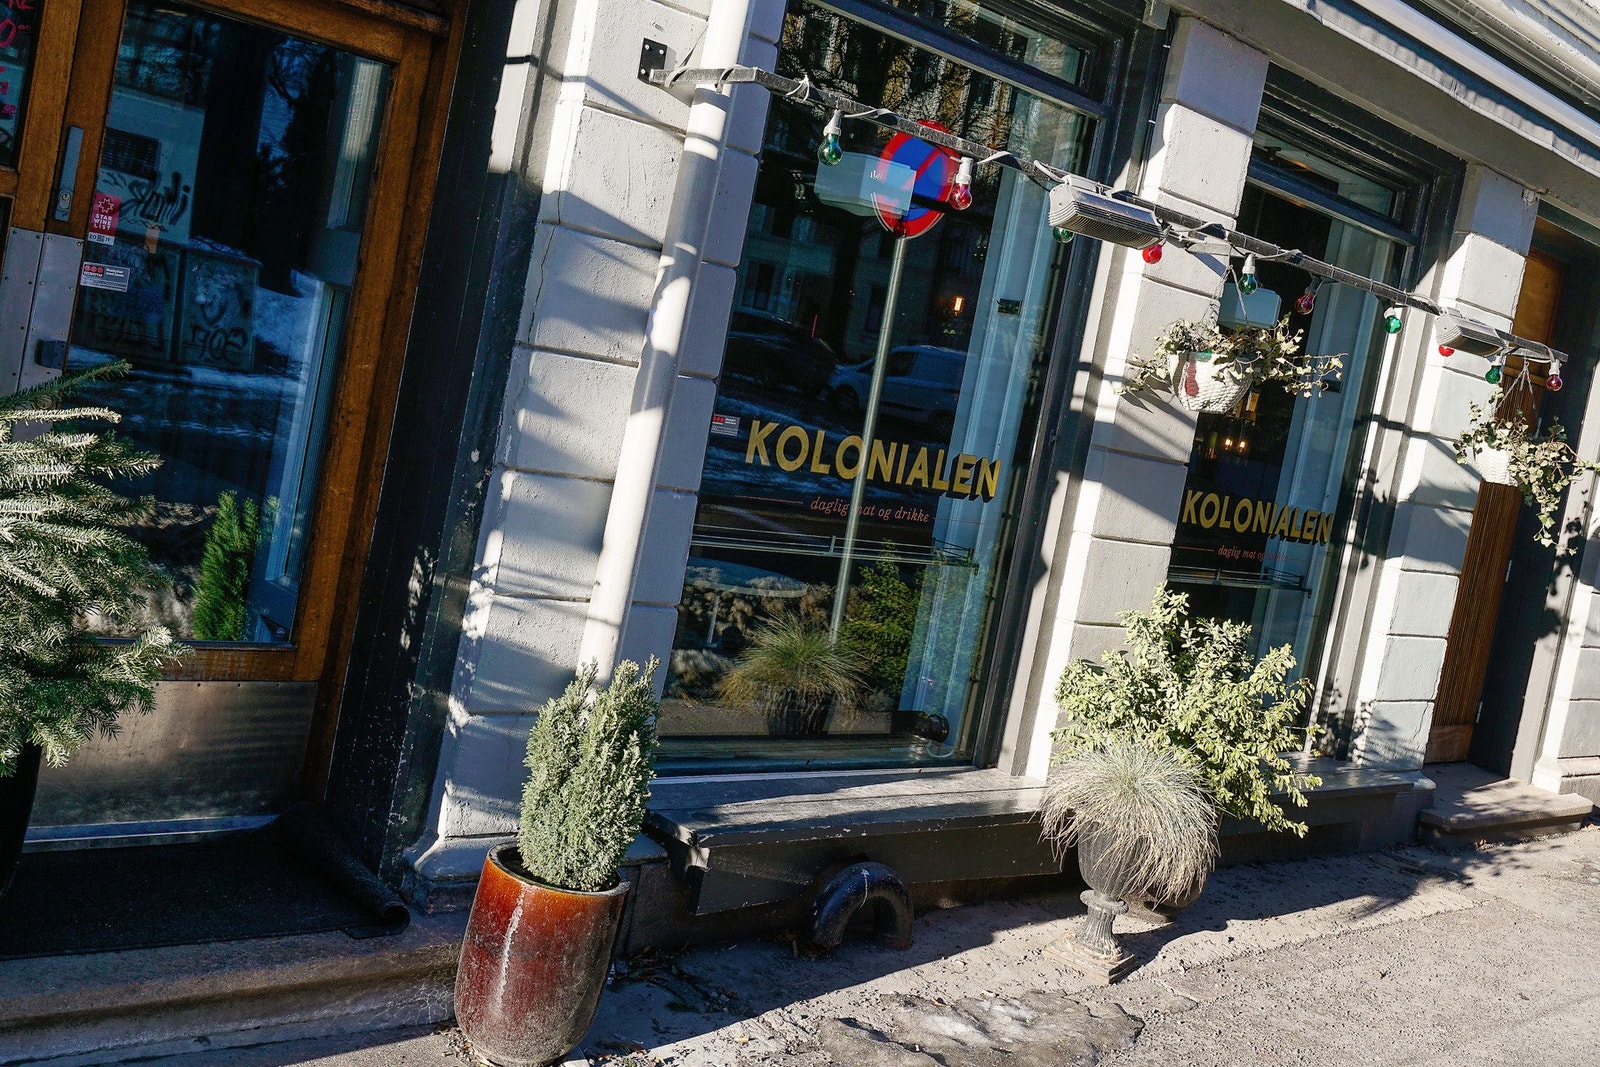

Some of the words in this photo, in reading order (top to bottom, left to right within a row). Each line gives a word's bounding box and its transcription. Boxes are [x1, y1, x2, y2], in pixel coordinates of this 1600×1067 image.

[93, 218, 112, 227] WINE
[95, 213, 113, 221] STAR
[93, 223, 111, 231] LIST
[745, 420, 1002, 499] KOLONIALEN
[810, 496, 850, 516] daglig
[878, 508, 892, 521] og
[894, 506, 930, 523] drikke
[1181, 489, 1334, 543] KOLONIALEN
[1217, 544, 1241, 560] daglig
